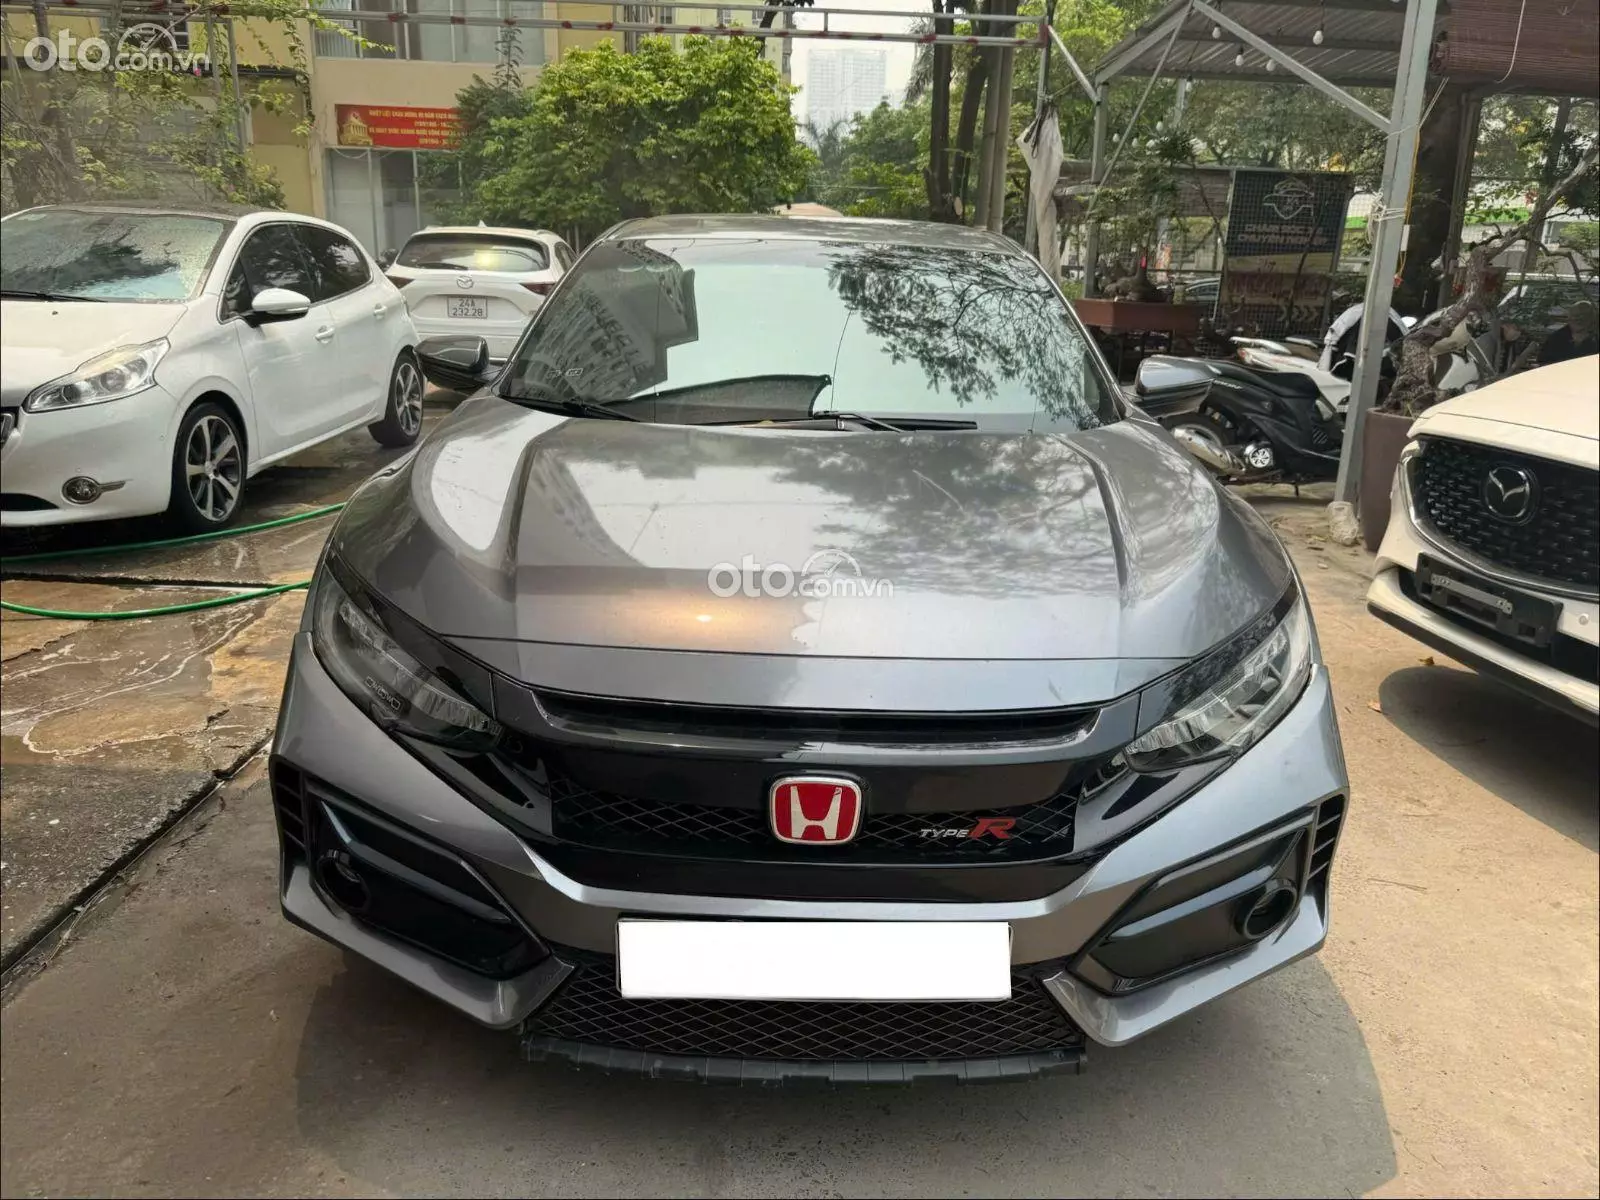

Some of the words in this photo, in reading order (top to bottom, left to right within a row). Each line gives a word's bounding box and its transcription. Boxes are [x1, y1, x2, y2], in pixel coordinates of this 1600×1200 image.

[459, 297, 476, 307] 24A
[452, 307, 483, 317] 232.28
[919, 828, 969, 838] TYPE
